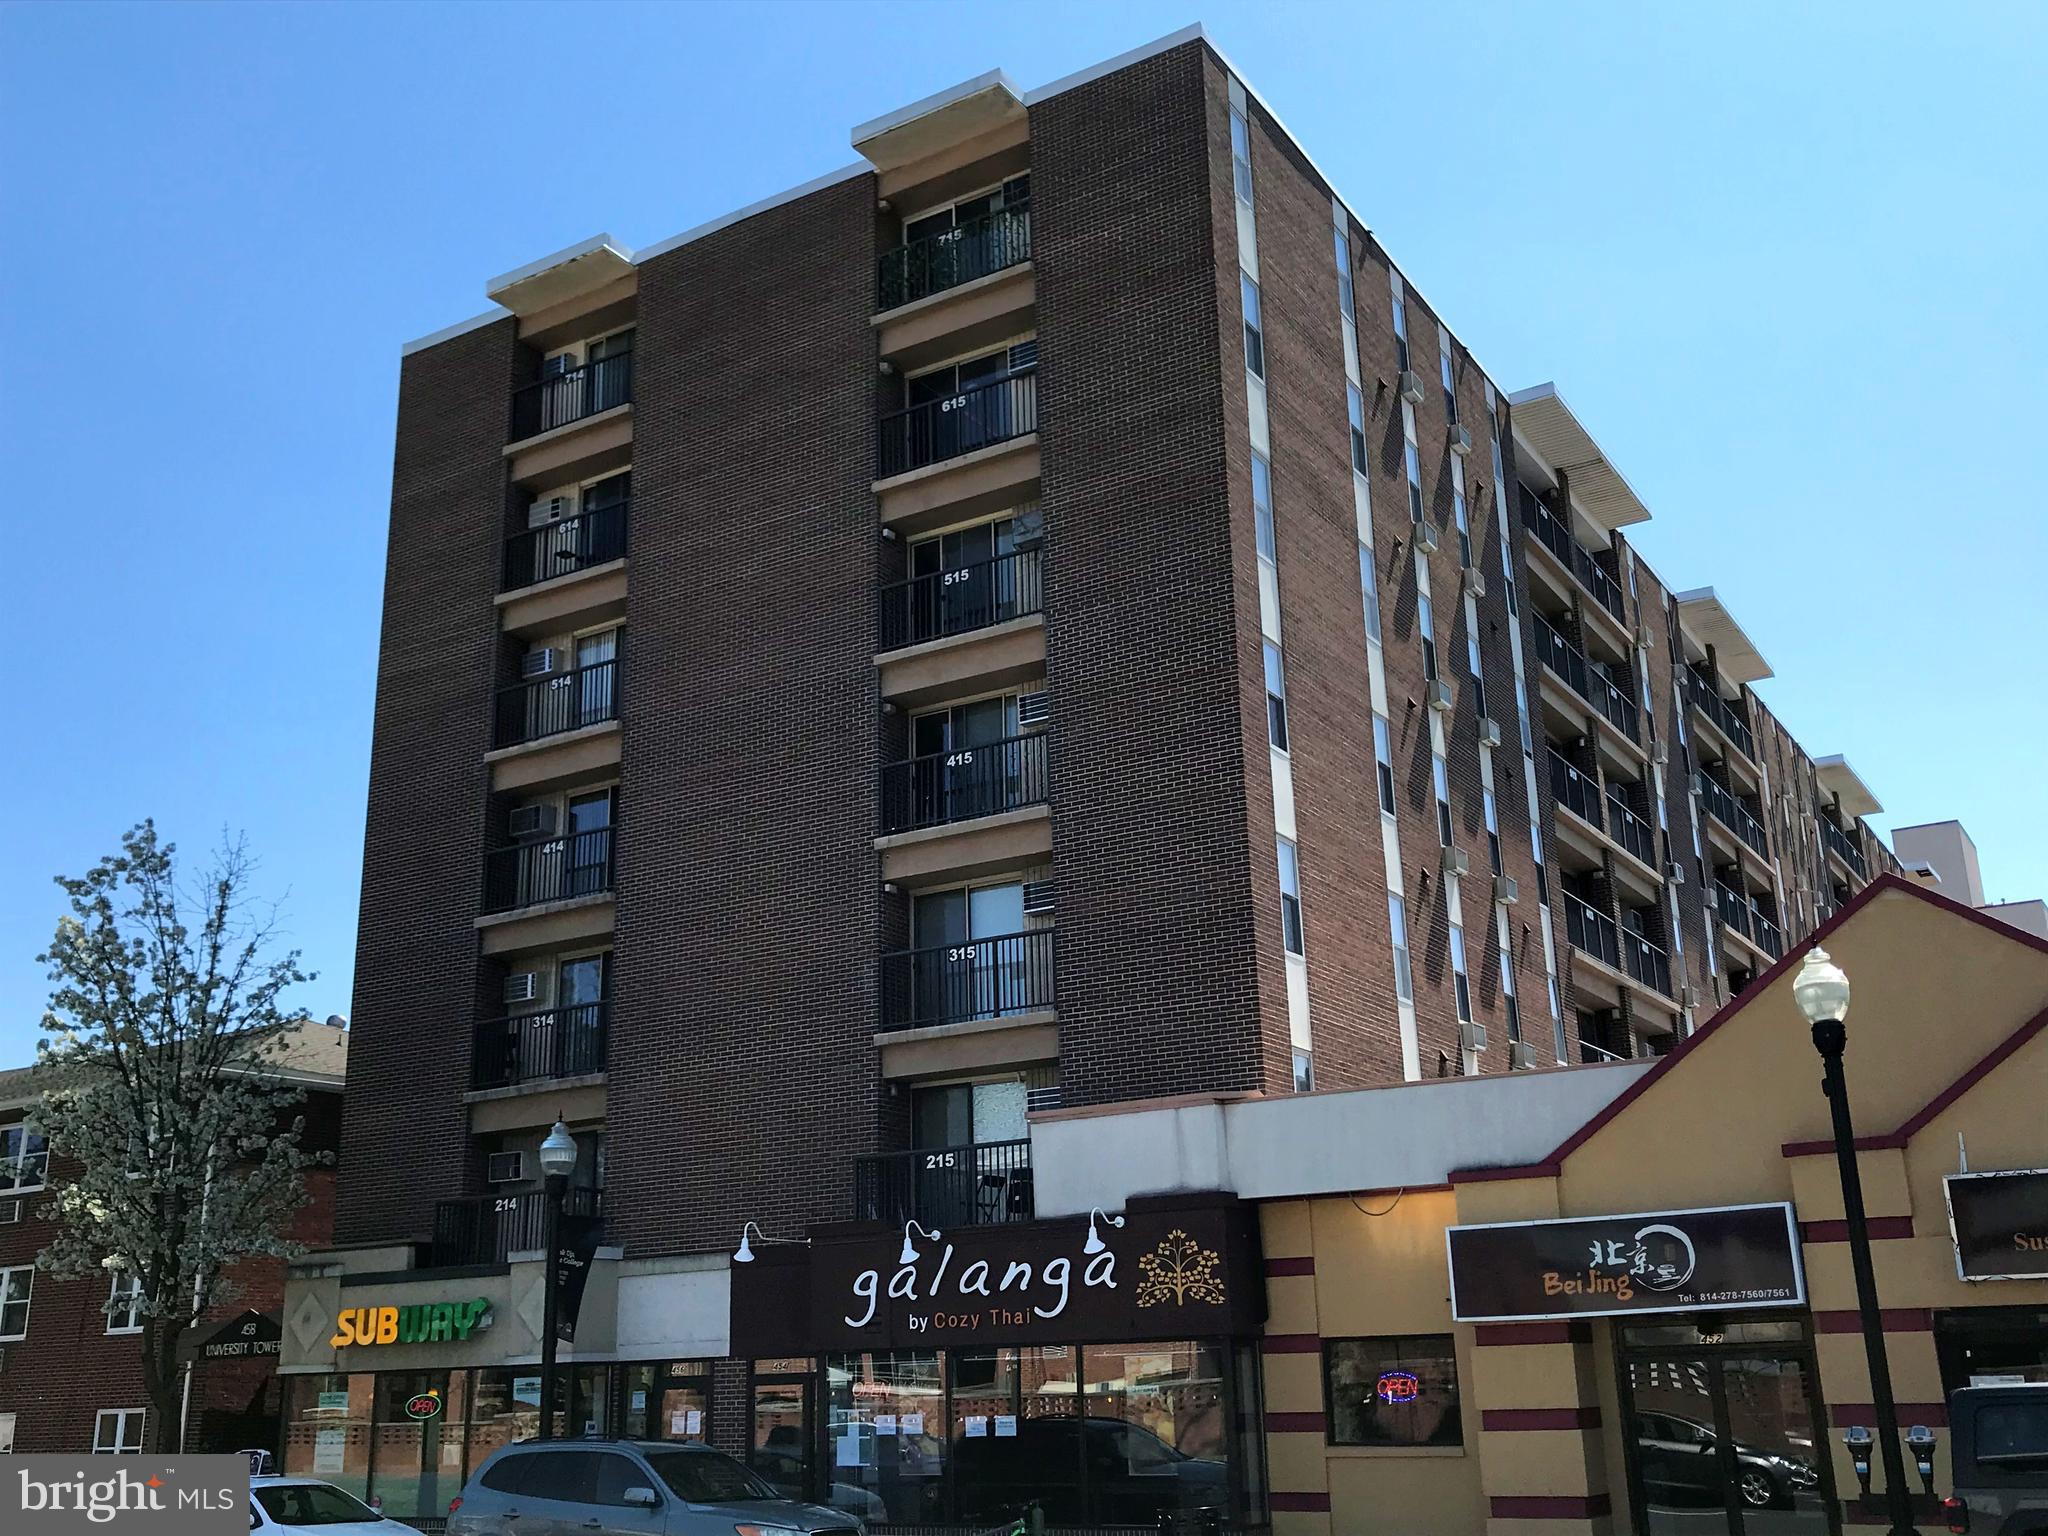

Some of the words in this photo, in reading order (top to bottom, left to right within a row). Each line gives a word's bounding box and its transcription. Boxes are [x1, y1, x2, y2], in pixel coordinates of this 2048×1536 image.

[565, 369, 584, 383] 714
[942, 396, 966, 412] 615
[559, 519, 579, 533] 614
[944, 569, 969, 585] 515
[551, 675, 571, 689] 514
[947, 752, 972, 766] 415
[543, 840, 564, 853] 414
[949, 946, 975, 961] 315
[533, 1014, 554, 1027] 314
[926, 1153, 954, 1169] 215
[495, 1198, 516, 1212] 214
[1589, 1239, 1655, 1276] 北京
[844, 1243, 1118, 1328] galanga
[1678, 1294, 1695, 1303] Tel:
[1700, 1288, 1791, 1302] 814-278-7560/7561
[329, 1297, 488, 1350] SUBWAY
[909, 1313, 928, 1333] by
[934, 1311, 981, 1331] Cozy
[989, 1307, 1032, 1326] Thai
[241, 1323, 256, 1335] 458
[1700, 1333, 1724, 1344] 452
[206, 1342, 251, 1356] UNIVERSITY
[852, 1381, 892, 1398] OPEN
[1377, 1379, 1418, 1396] OPEN
[410, 1400, 436, 1413] OPEN
